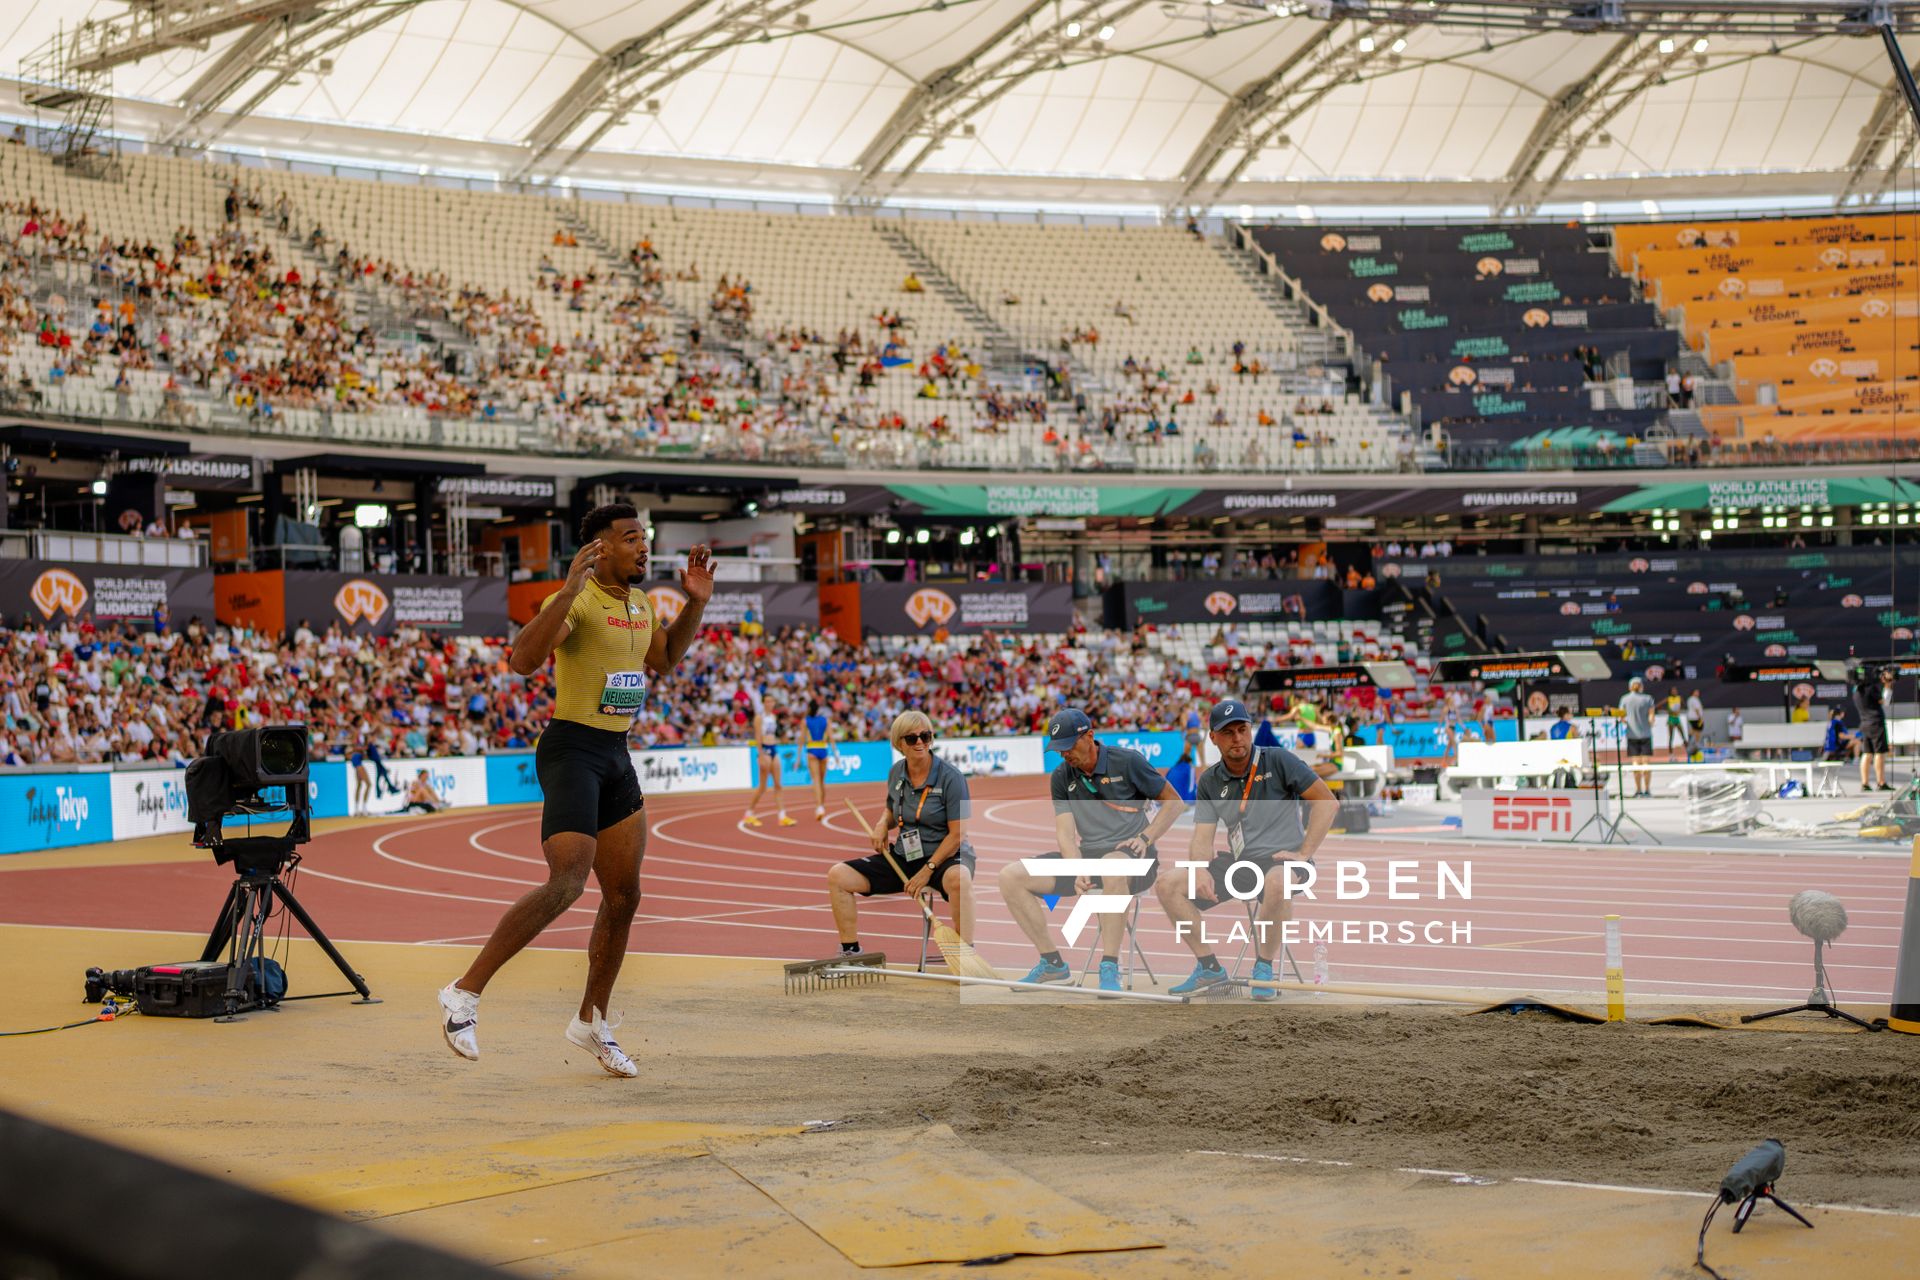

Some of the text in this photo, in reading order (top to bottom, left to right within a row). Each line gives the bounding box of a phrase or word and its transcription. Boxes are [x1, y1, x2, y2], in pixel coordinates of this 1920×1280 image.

[987, 486, 1099, 499] WORLD ATHLETICS
[1462, 492, 1578, 506] #WABUDAPEST23
[987, 500, 1100, 515] CHAMPIONSHIPS
[1224, 494, 1336, 508] #WORLDCHAMPS
[94, 578, 167, 592] WORLD ATHLETICS
[95, 602, 153, 616] BUDAPEST
[622, 673, 644, 687] TDK
[967, 745, 1009, 769] Tokyo
[678, 756, 718, 782] Tokyo
[163, 780, 187, 818] Toky
[56, 786, 89, 831] Tokyo
[1493, 797, 1572, 832] ESPN
